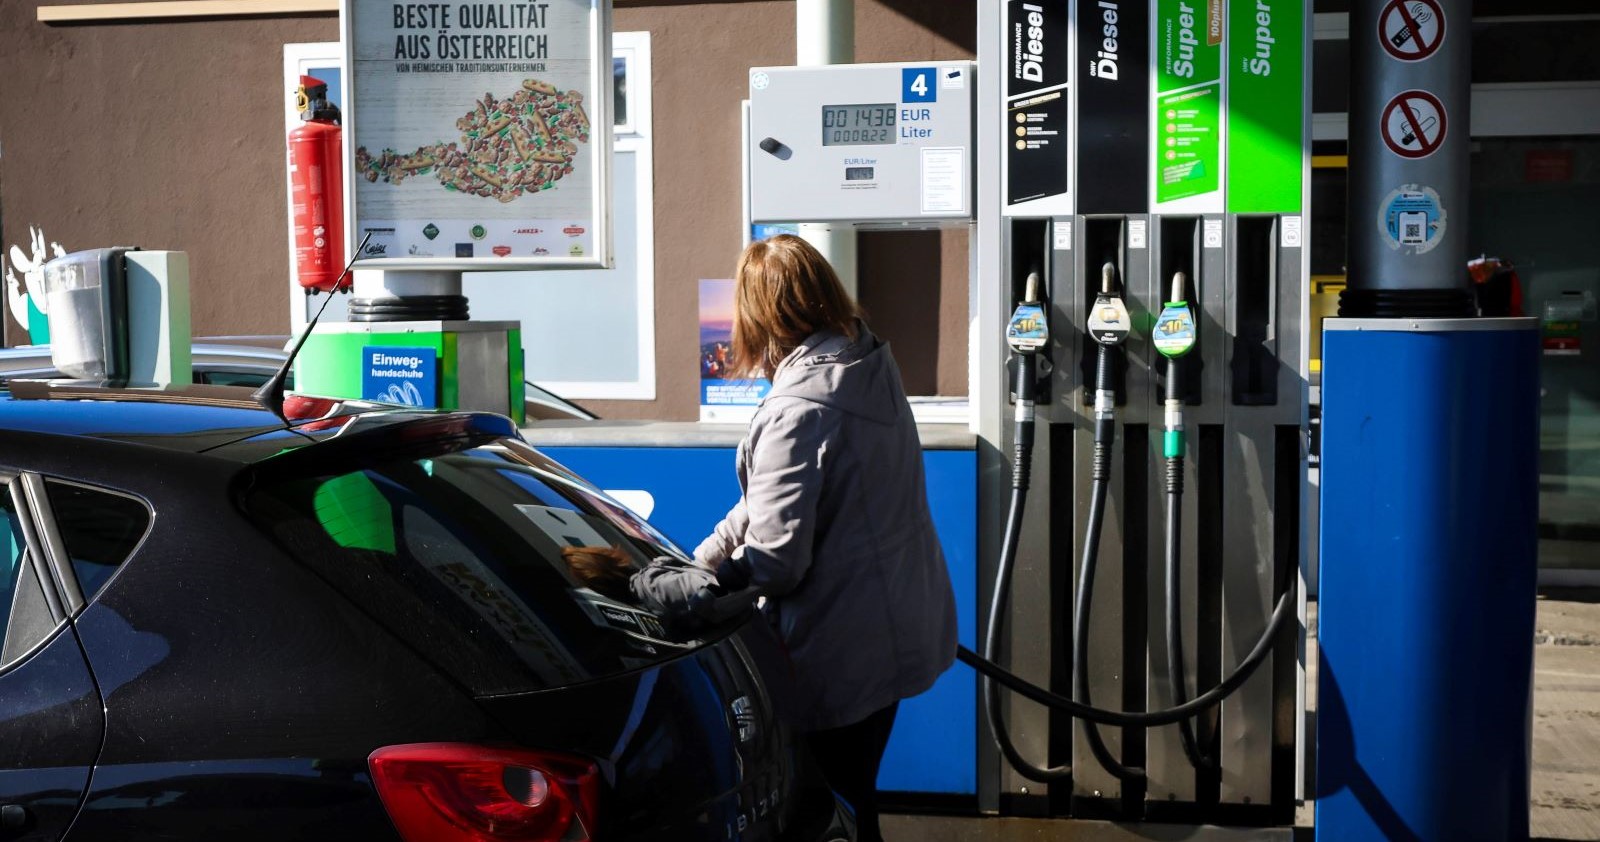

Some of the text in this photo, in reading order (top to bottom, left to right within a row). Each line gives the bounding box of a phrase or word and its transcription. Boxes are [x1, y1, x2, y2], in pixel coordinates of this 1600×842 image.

[393, 0, 548, 29] BESTE QUALITÄT
[394, 30, 547, 59] AUS ÖSTERREICH
[1022, 3, 1043, 83] Diesel
[1097, 1, 1118, 80] Diesel
[1173, 2, 1198, 79] Super
[1249, 0, 1275, 77] Super
[396, 63, 410, 73] VON
[412, 63, 453, 73] HEIMISCHEN
[1089, 60, 1097, 77] OMV
[910, 74, 928, 96] 4
[901, 109, 930, 120] EUR
[901, 127, 932, 138] Liter
[372, 353, 423, 368] Einweg-
[371, 368, 423, 378] handschuhe
